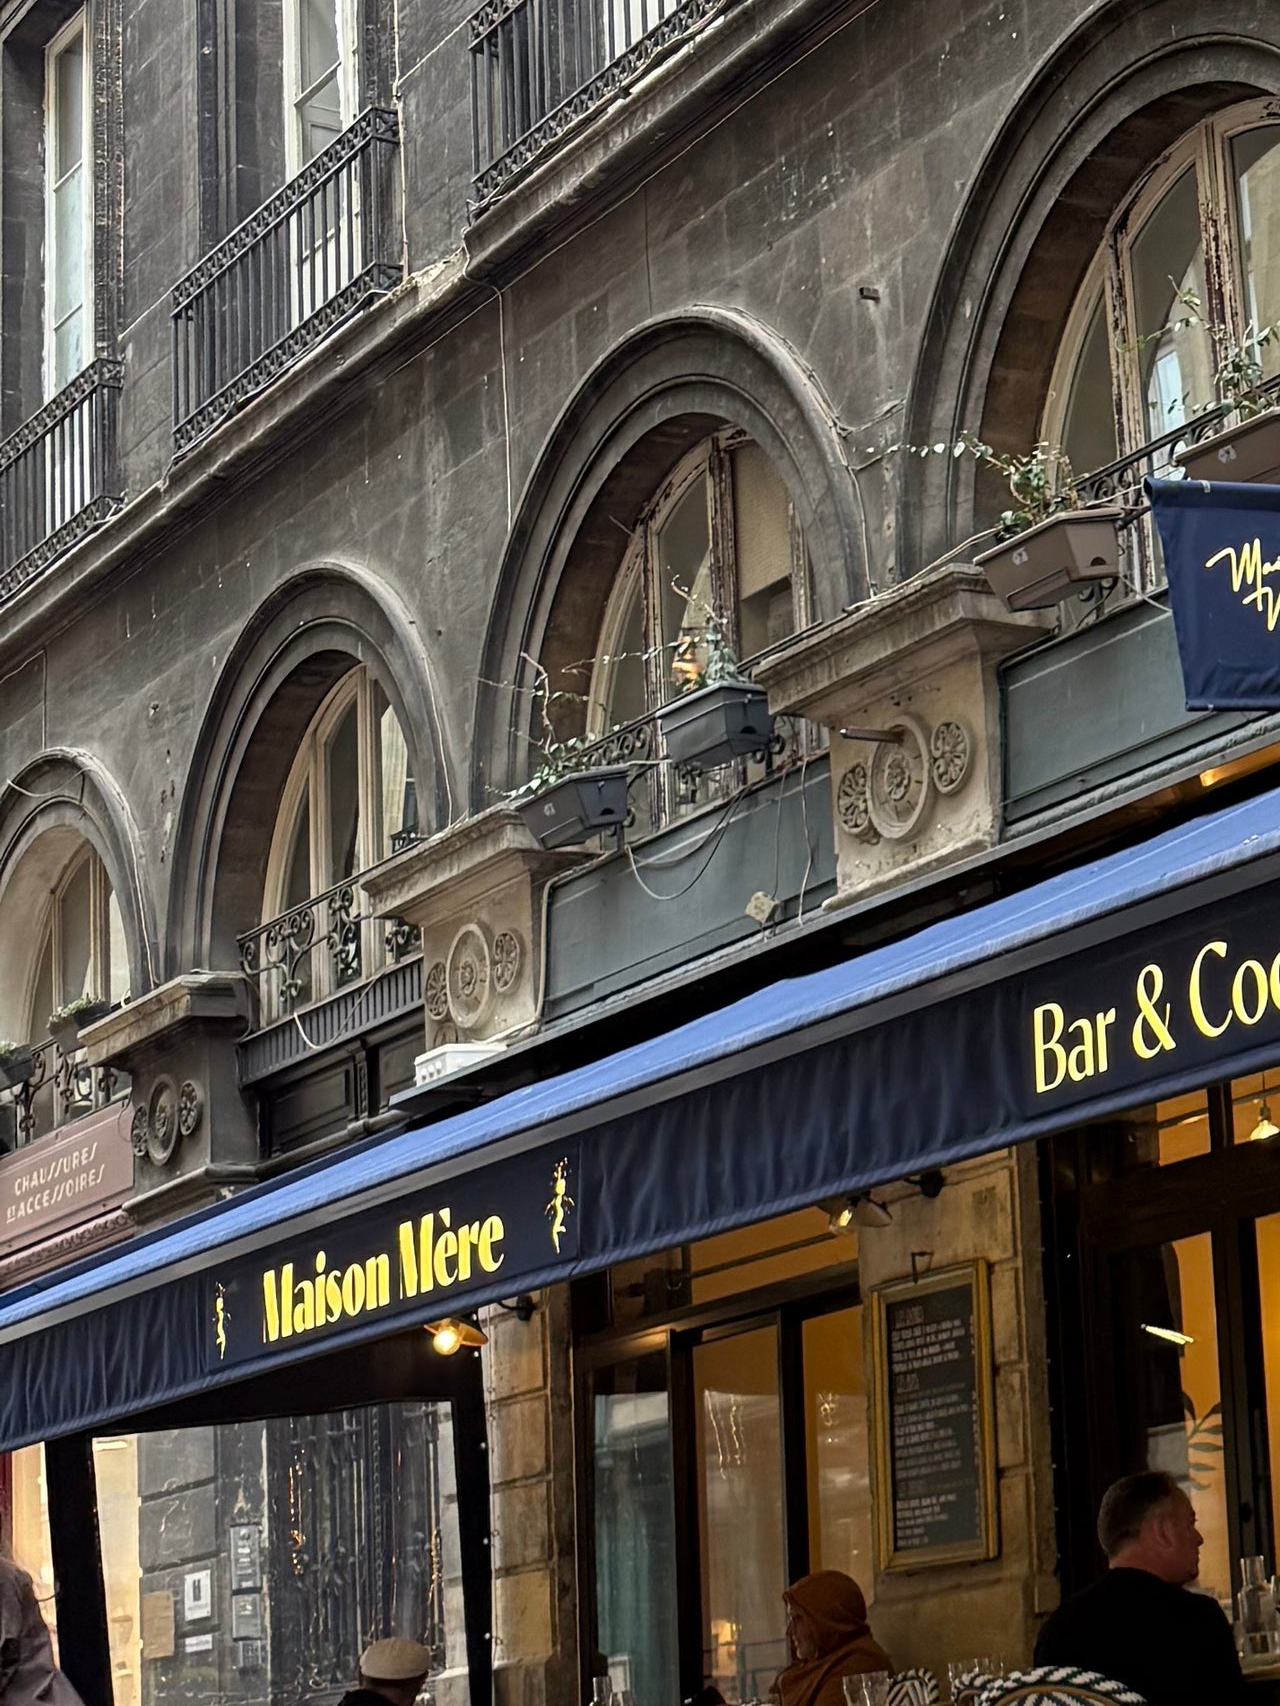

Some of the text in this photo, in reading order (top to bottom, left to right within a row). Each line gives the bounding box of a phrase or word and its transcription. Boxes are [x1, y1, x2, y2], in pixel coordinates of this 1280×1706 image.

[1033, 1001, 1117, 1094] Bar
[1131, 963, 1177, 1059] &
[14, 1141, 98, 1197] CHAUSSURES
[17, 1163, 105, 1219] ACCESSOIRES
[262, 1206, 505, 1344] Maison Mère
